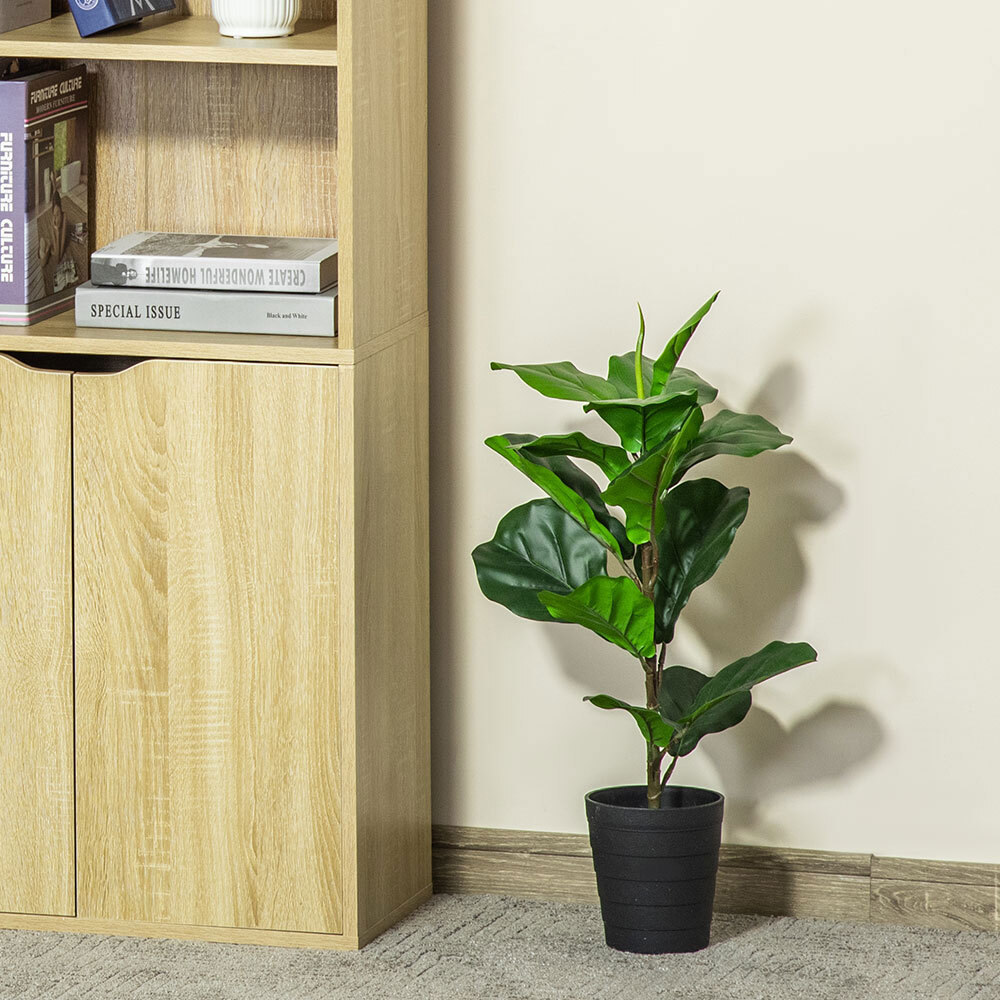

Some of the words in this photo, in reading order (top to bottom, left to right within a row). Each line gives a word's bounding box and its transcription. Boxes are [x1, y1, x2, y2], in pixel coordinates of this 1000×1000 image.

[0, 132, 14, 212] FURNITURE
[0, 218, 14, 283] CULTURE
[145, 266, 197, 285] HOMELIFE
[200, 267, 265, 286] WONDERFUL
[268, 268, 306, 287] CREATE
[90, 303, 142, 319] SPECIAL
[145, 304, 181, 320] ISSUE
[266, 311, 281, 320] Black
[282, 311, 292, 320] and
[292, 312, 308, 321] White
